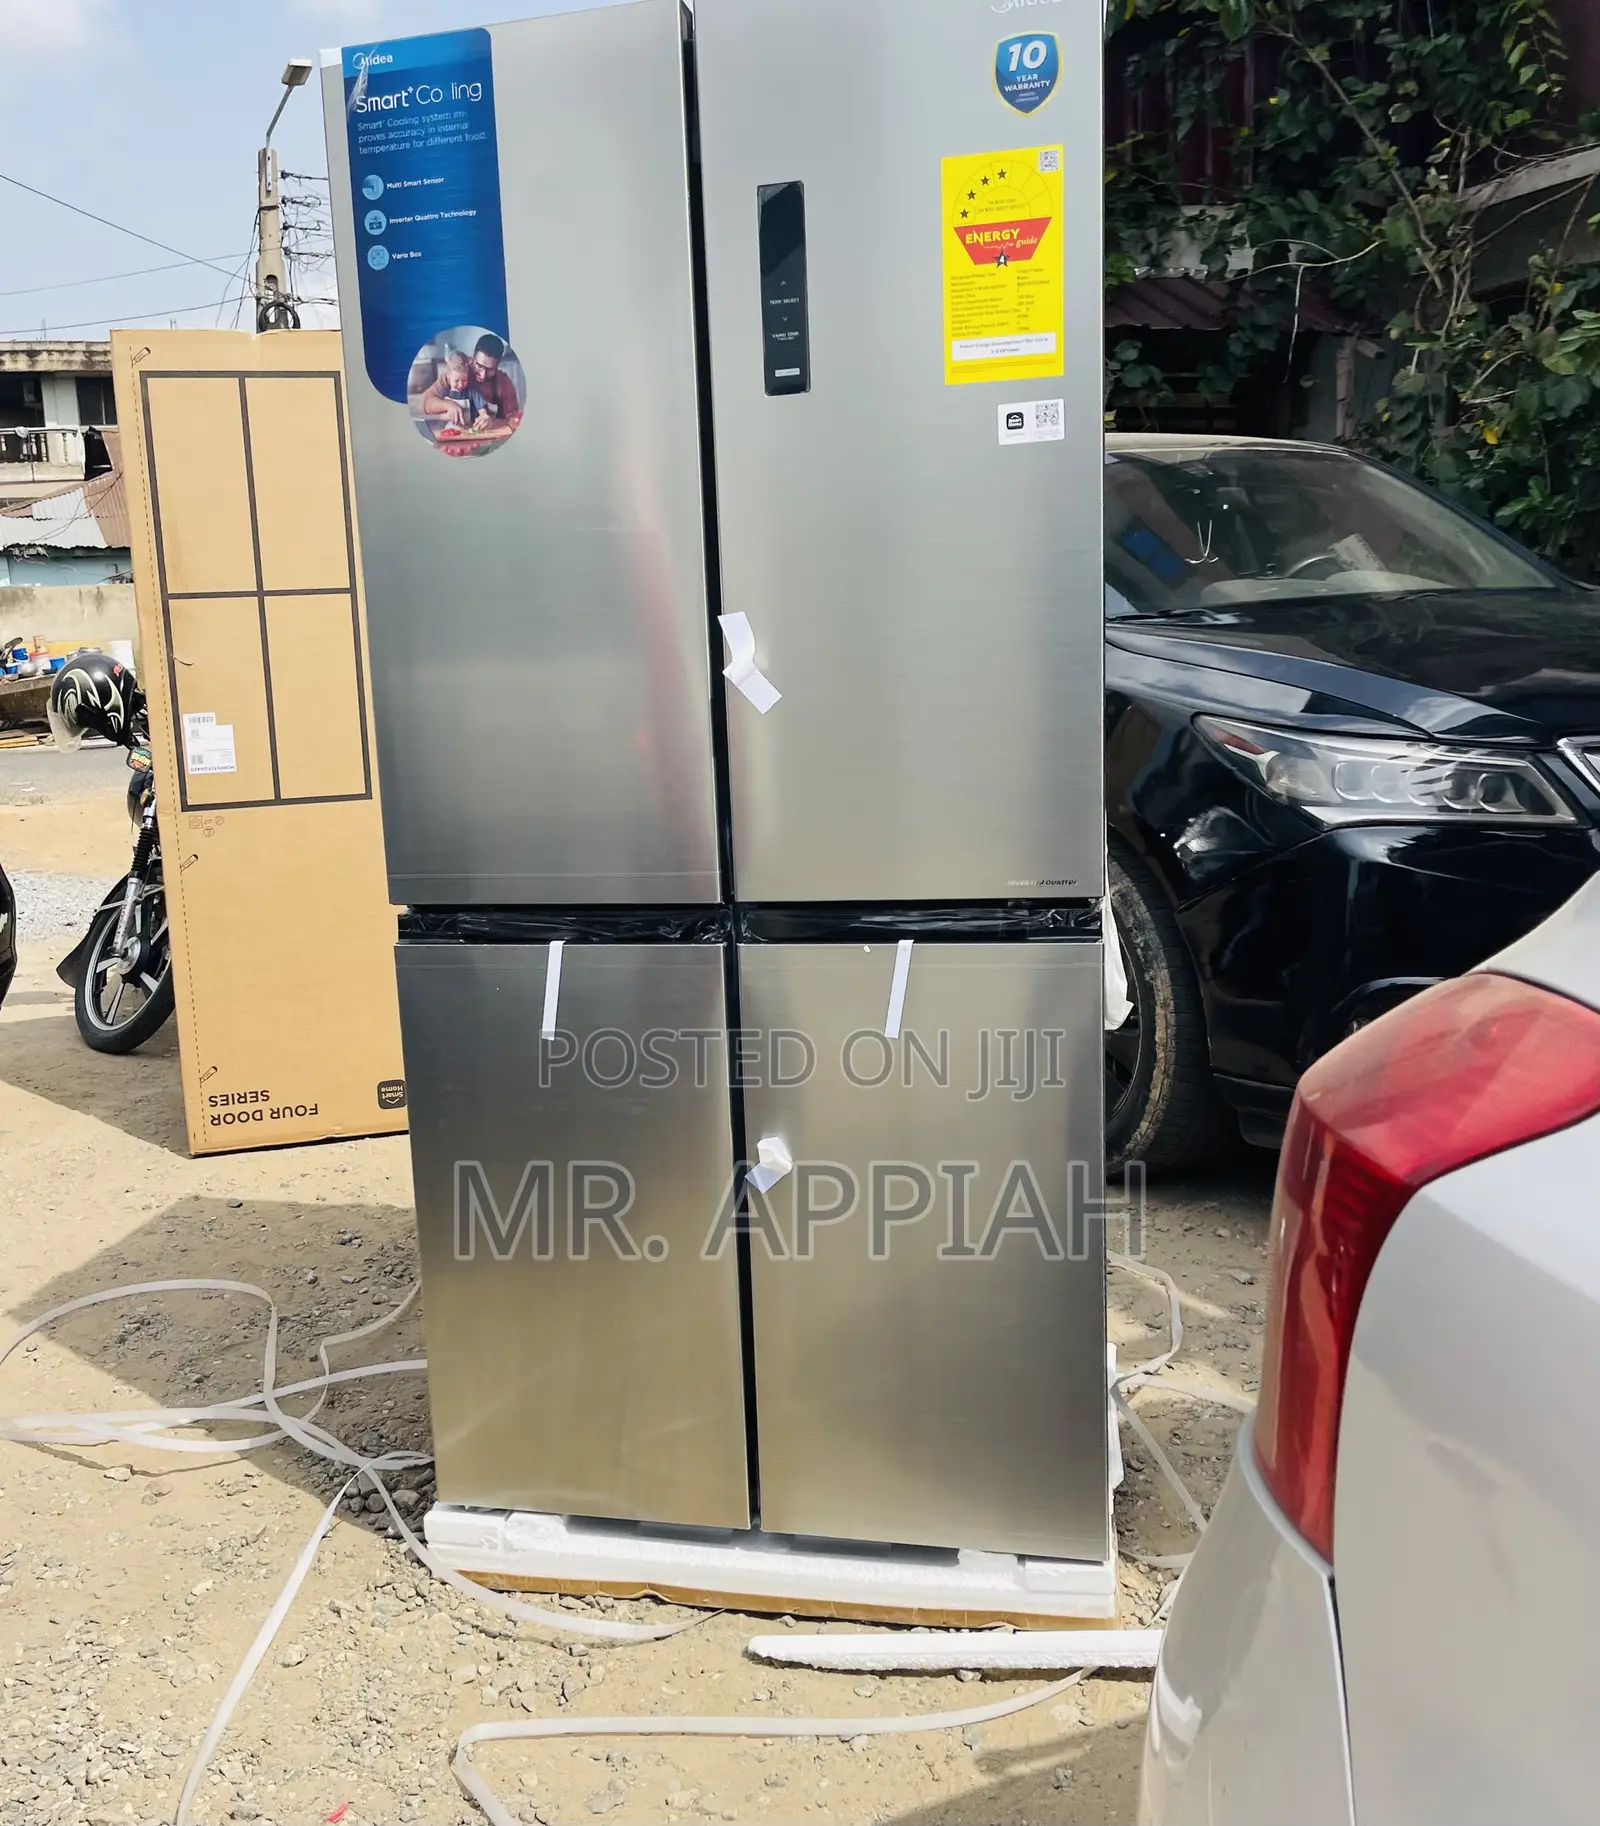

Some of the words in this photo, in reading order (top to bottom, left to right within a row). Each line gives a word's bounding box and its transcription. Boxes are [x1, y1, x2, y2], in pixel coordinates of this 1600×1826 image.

[353, 52, 393, 69] Midea
[1008, 39, 1047, 72] 10
[1016, 73, 1038, 82] YEAR
[1004, 80, 1051, 92] WARRANTY
[387, 115, 419, 127] Cooling
[421, 111, 452, 124] system
[358, 132, 386, 143] proves
[388, 127, 425, 138] accuracy
[428, 126, 436, 134] in
[360, 141, 411, 154] temperature
[413, 139, 424, 148] for
[426, 135, 463, 146] different
[387, 181, 402, 189] Multi
[403, 179, 421, 187] Smart
[423, 177, 445, 185] Sensor
[389, 215, 413, 224] Inverter
[414, 213, 439, 221] Quattro
[440, 209, 477, 218] Technology
[965, 228, 1021, 246] ENERGY
[1015, 236, 1038, 248] guide
[392, 252, 408, 260] Vario
[208, 1089, 270, 1107] SERIES
[381, 1091, 404, 1099] Smart
[210, 1109, 264, 1126] DOOR
[270, 1103, 319, 1120] FOUR
